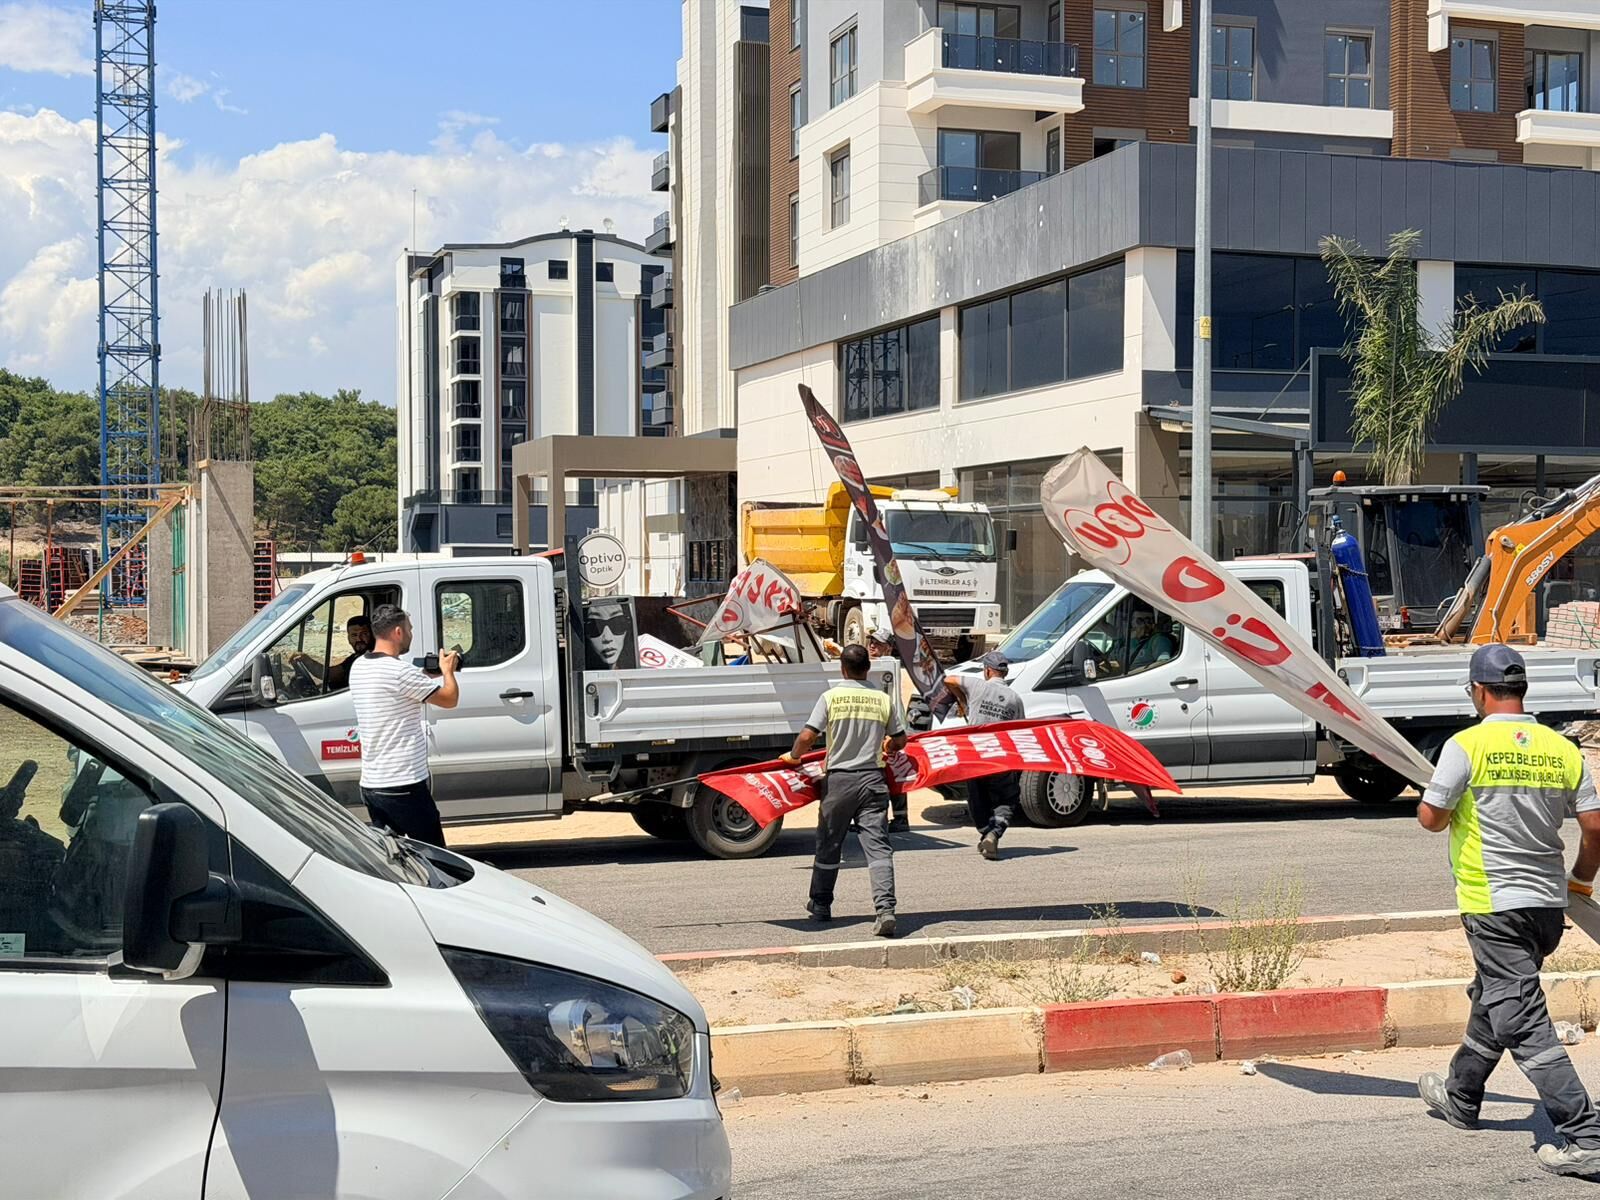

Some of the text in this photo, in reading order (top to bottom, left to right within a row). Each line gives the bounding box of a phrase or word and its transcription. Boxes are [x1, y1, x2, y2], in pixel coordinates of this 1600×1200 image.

[580, 552, 622, 566] Optiva
[590, 565, 613, 574] Optik
[326, 744, 360, 754] TEMİZLİK
[1486, 752, 1516, 765] KEPEZ
